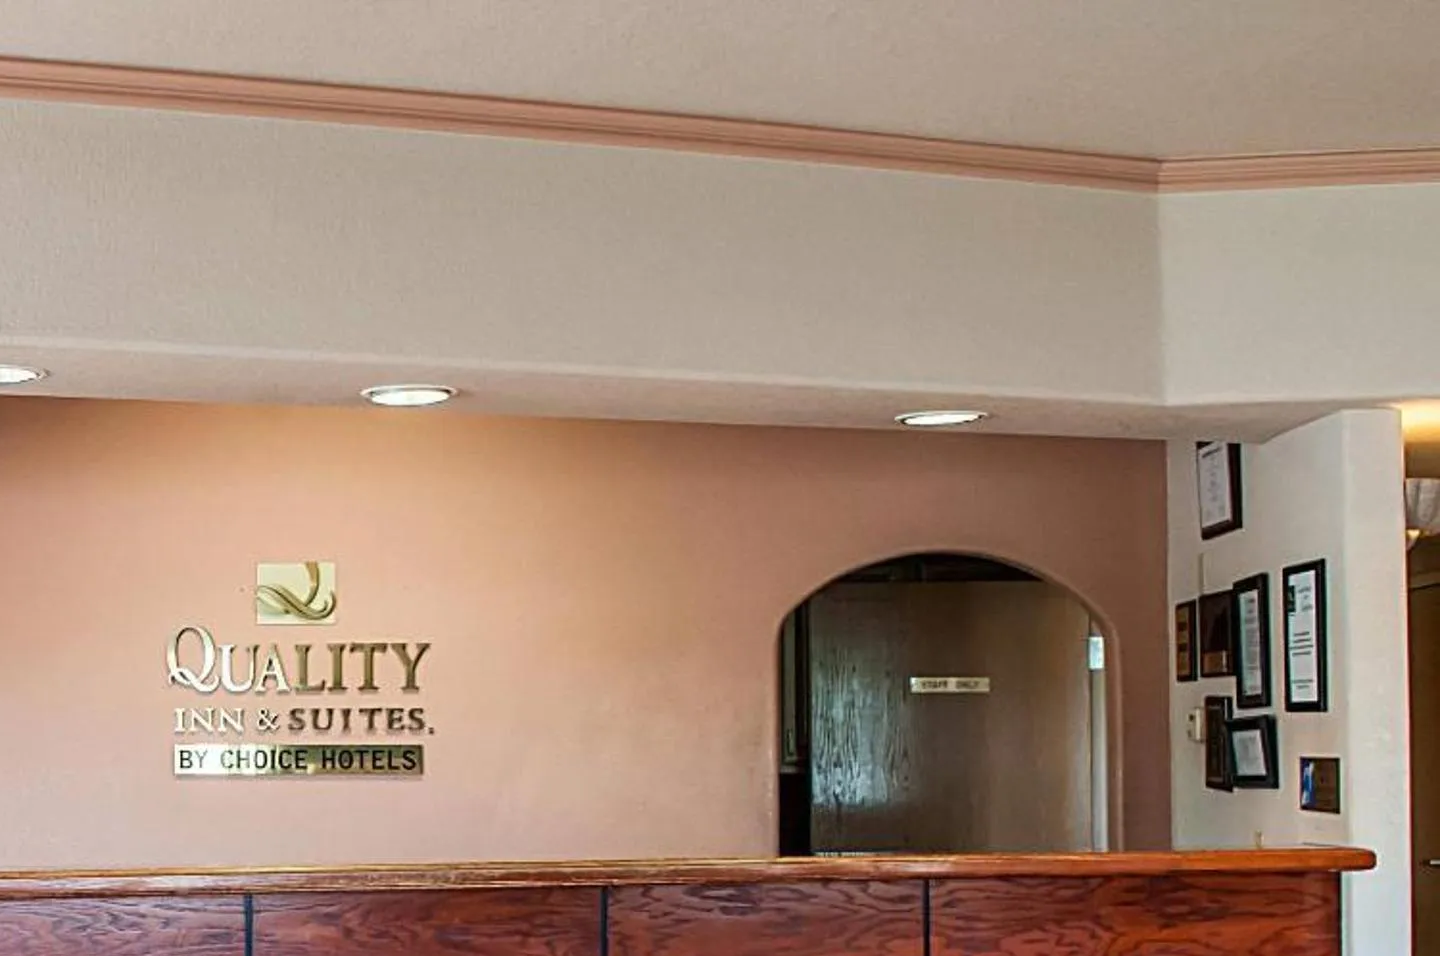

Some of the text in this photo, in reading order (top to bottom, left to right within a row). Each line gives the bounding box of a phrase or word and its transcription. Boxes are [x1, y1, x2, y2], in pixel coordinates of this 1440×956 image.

[166, 625, 431, 693] QUALITY
[174, 707, 245, 733] INN
[257, 707, 281, 732] &
[179, 749, 417, 770] BY CHOICE HOTELS
